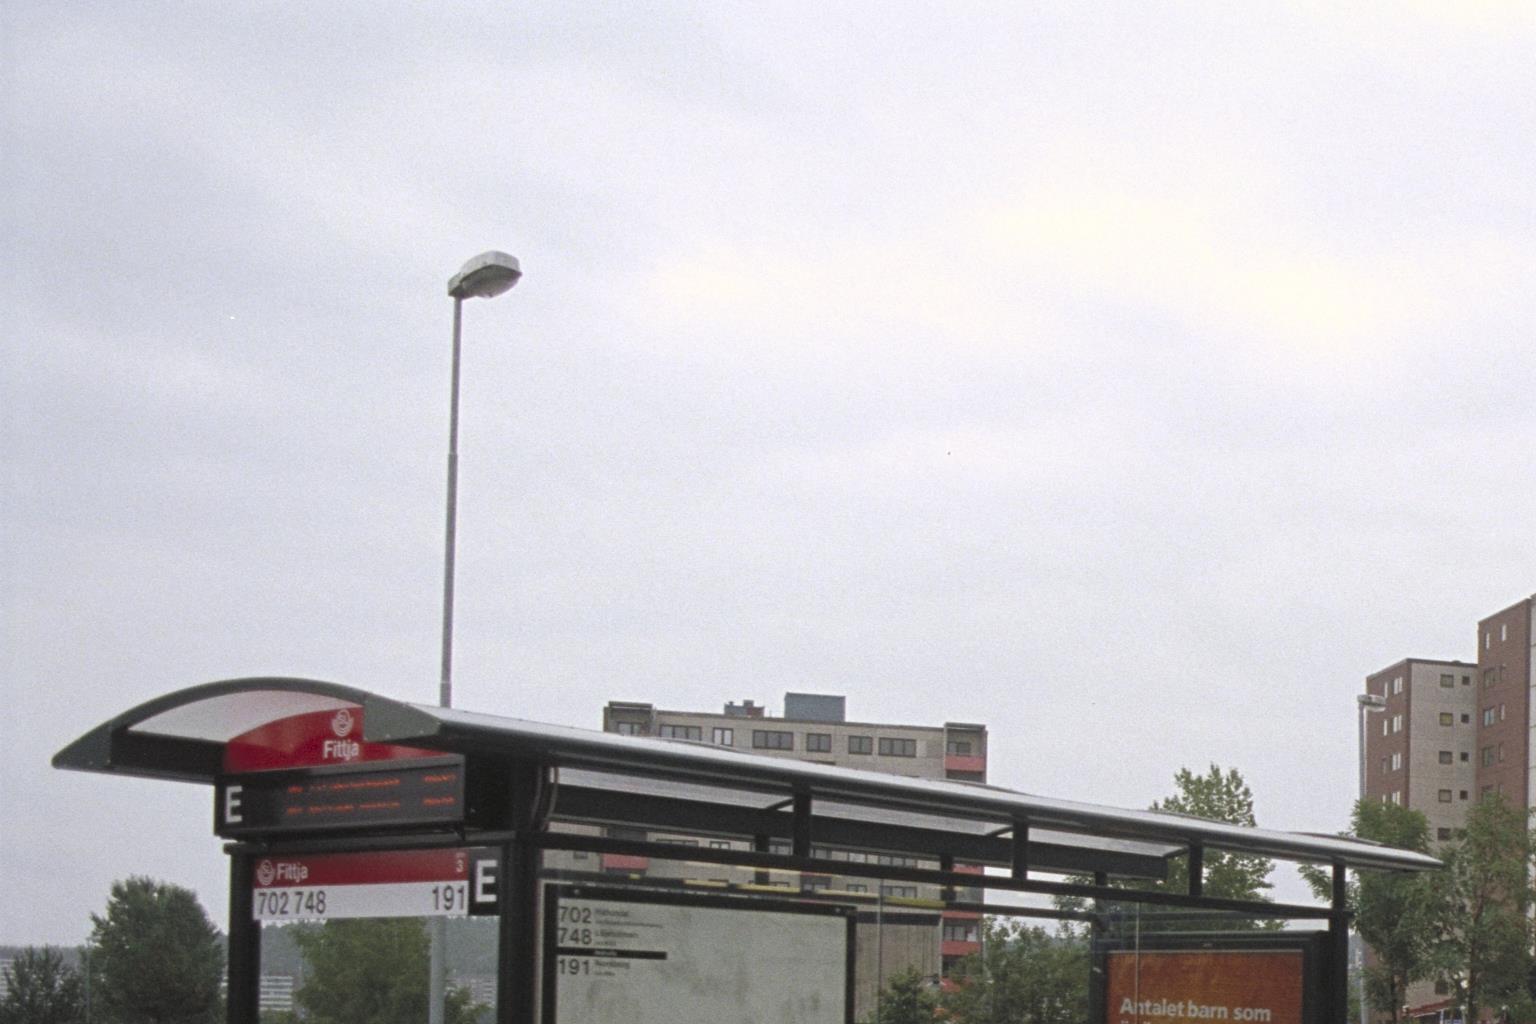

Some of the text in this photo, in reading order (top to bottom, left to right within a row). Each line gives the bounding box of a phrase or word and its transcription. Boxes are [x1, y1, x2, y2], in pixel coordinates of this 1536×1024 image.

[323, 740, 359, 760] Fittja
[225, 785, 243, 824] E
[276, 863, 308, 882] Fittja
[475, 860, 498, 902] E
[258, 885, 465, 915] 702 748 191
[560, 906, 592, 924] 702
[558, 928, 592, 945] 748
[560, 959, 589, 975] 191
[1120, 998, 1271, 1022] Antalet barn som
